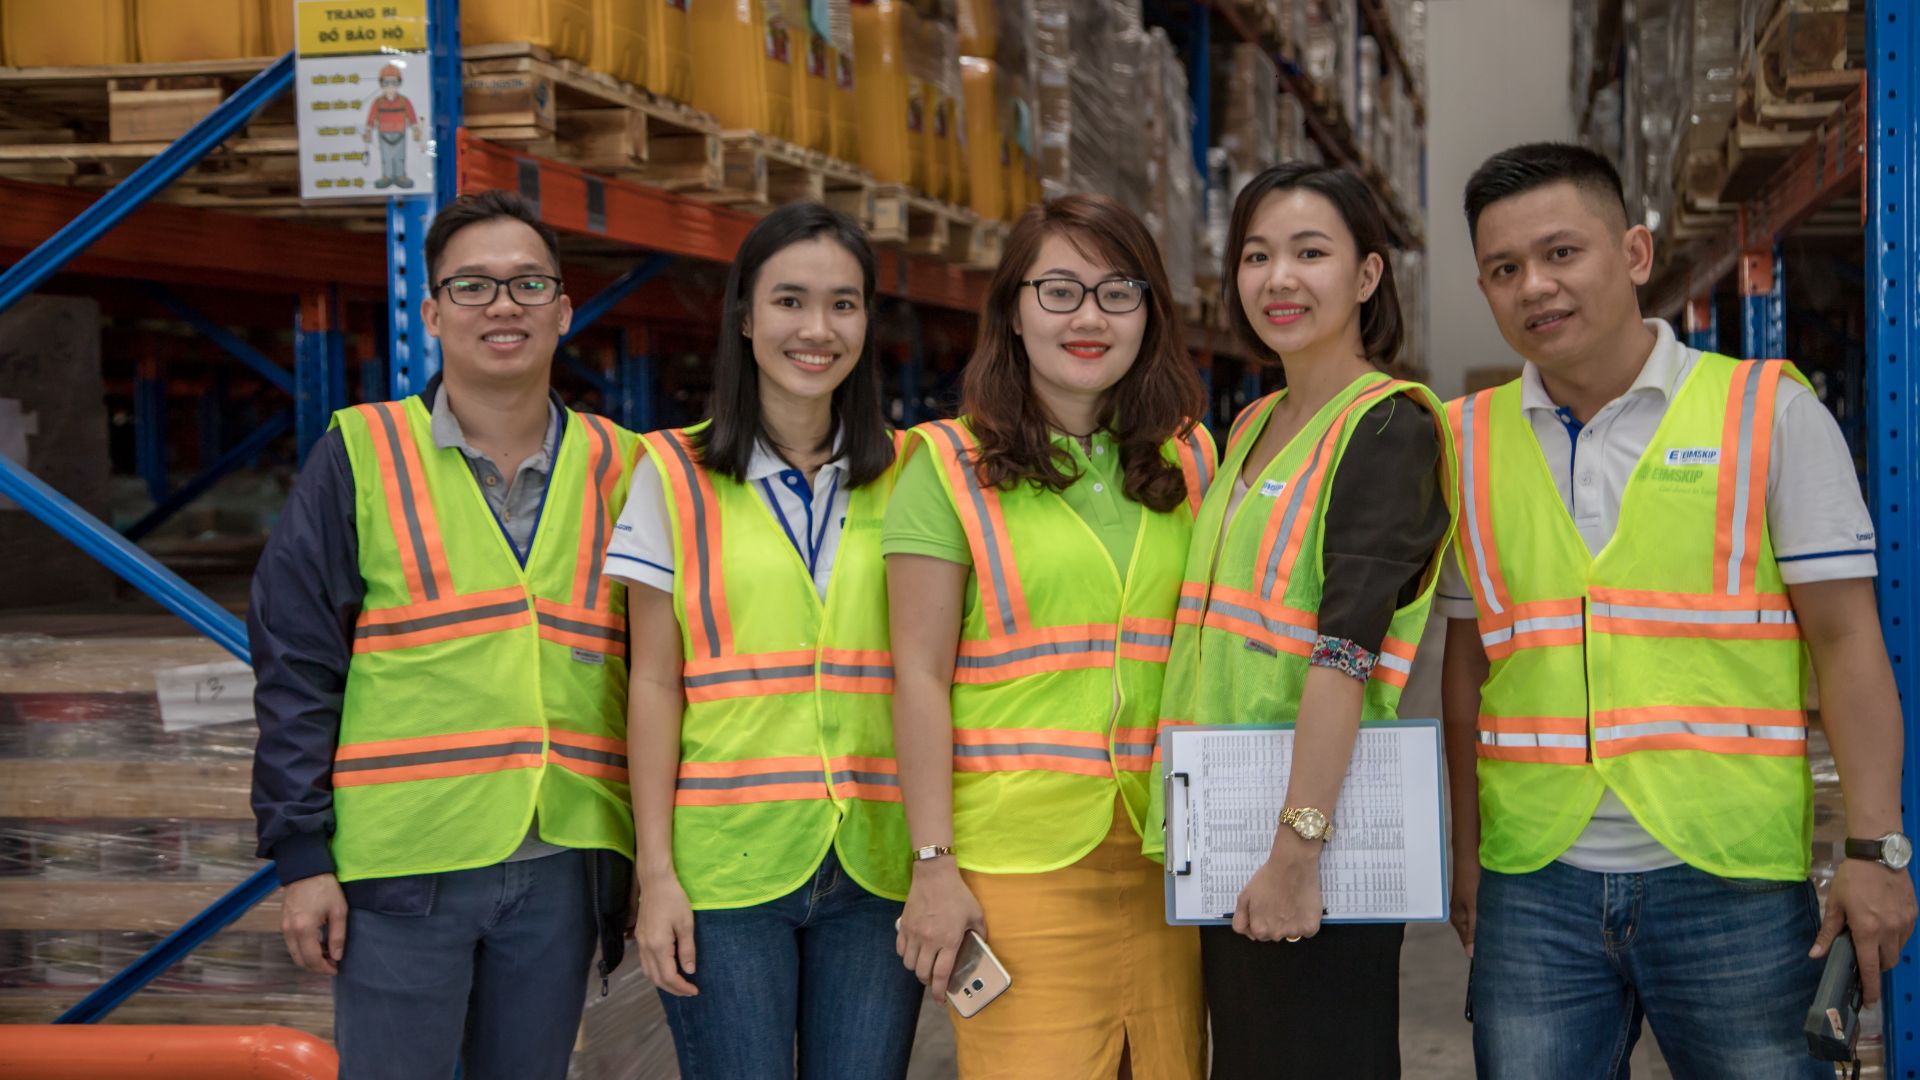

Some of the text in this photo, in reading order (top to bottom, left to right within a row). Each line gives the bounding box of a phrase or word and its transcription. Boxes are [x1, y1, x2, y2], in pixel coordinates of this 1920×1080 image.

[325, 8, 375, 20] TRANG
[1682, 450, 1717, 459] EIMSKIP
[1651, 467, 1703, 483] EIMSKIP
